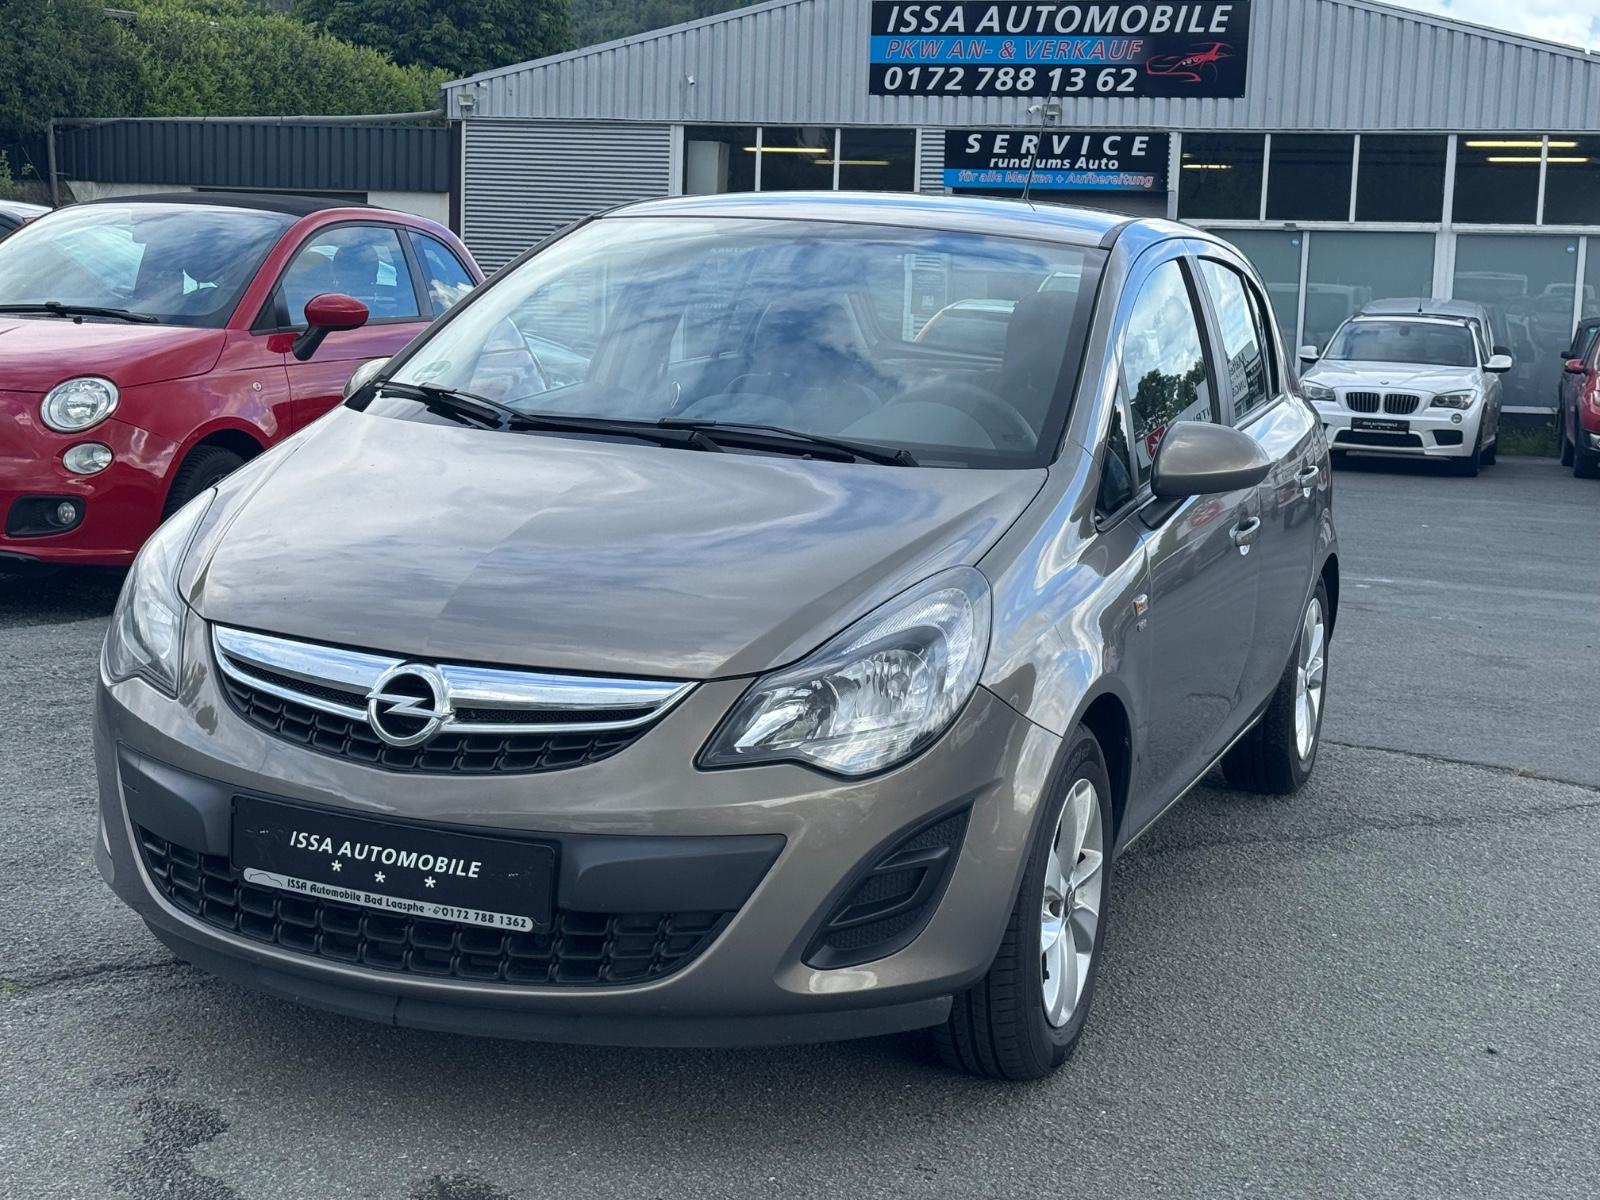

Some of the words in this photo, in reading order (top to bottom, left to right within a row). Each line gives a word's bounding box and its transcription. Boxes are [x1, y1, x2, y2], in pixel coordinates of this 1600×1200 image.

[886, 5, 965, 33] ISSA
[975, 5, 1232, 34] AUTOMOBILE
[885, 39, 944, 59] PKW
[946, 39, 993, 60] AN-
[999, 39, 1015, 60] &
[1025, 39, 1144, 61] VERKAUF
[884, 66, 965, 91] 0172
[975, 67, 1037, 92] 788
[1048, 67, 1087, 92] 13
[1096, 68, 1138, 93] 62
[965, 133, 1149, 156] SERVICE
[989, 155, 1032, 169] rund
[1035, 158, 1071, 169] ums
[1074, 156, 1119, 170] Auto
[289, 830, 334, 855] ISSA
[337, 841, 482, 879] AUTOMOBILE
[287, 878, 307, 891] ISSA
[310, 883, 361, 902] Automobile
[364, 894, 383, 906] Bad
[441, 907, 469, 920] 0172
[474, 912, 495, 924] 788
[499, 915, 527, 929] 1362
